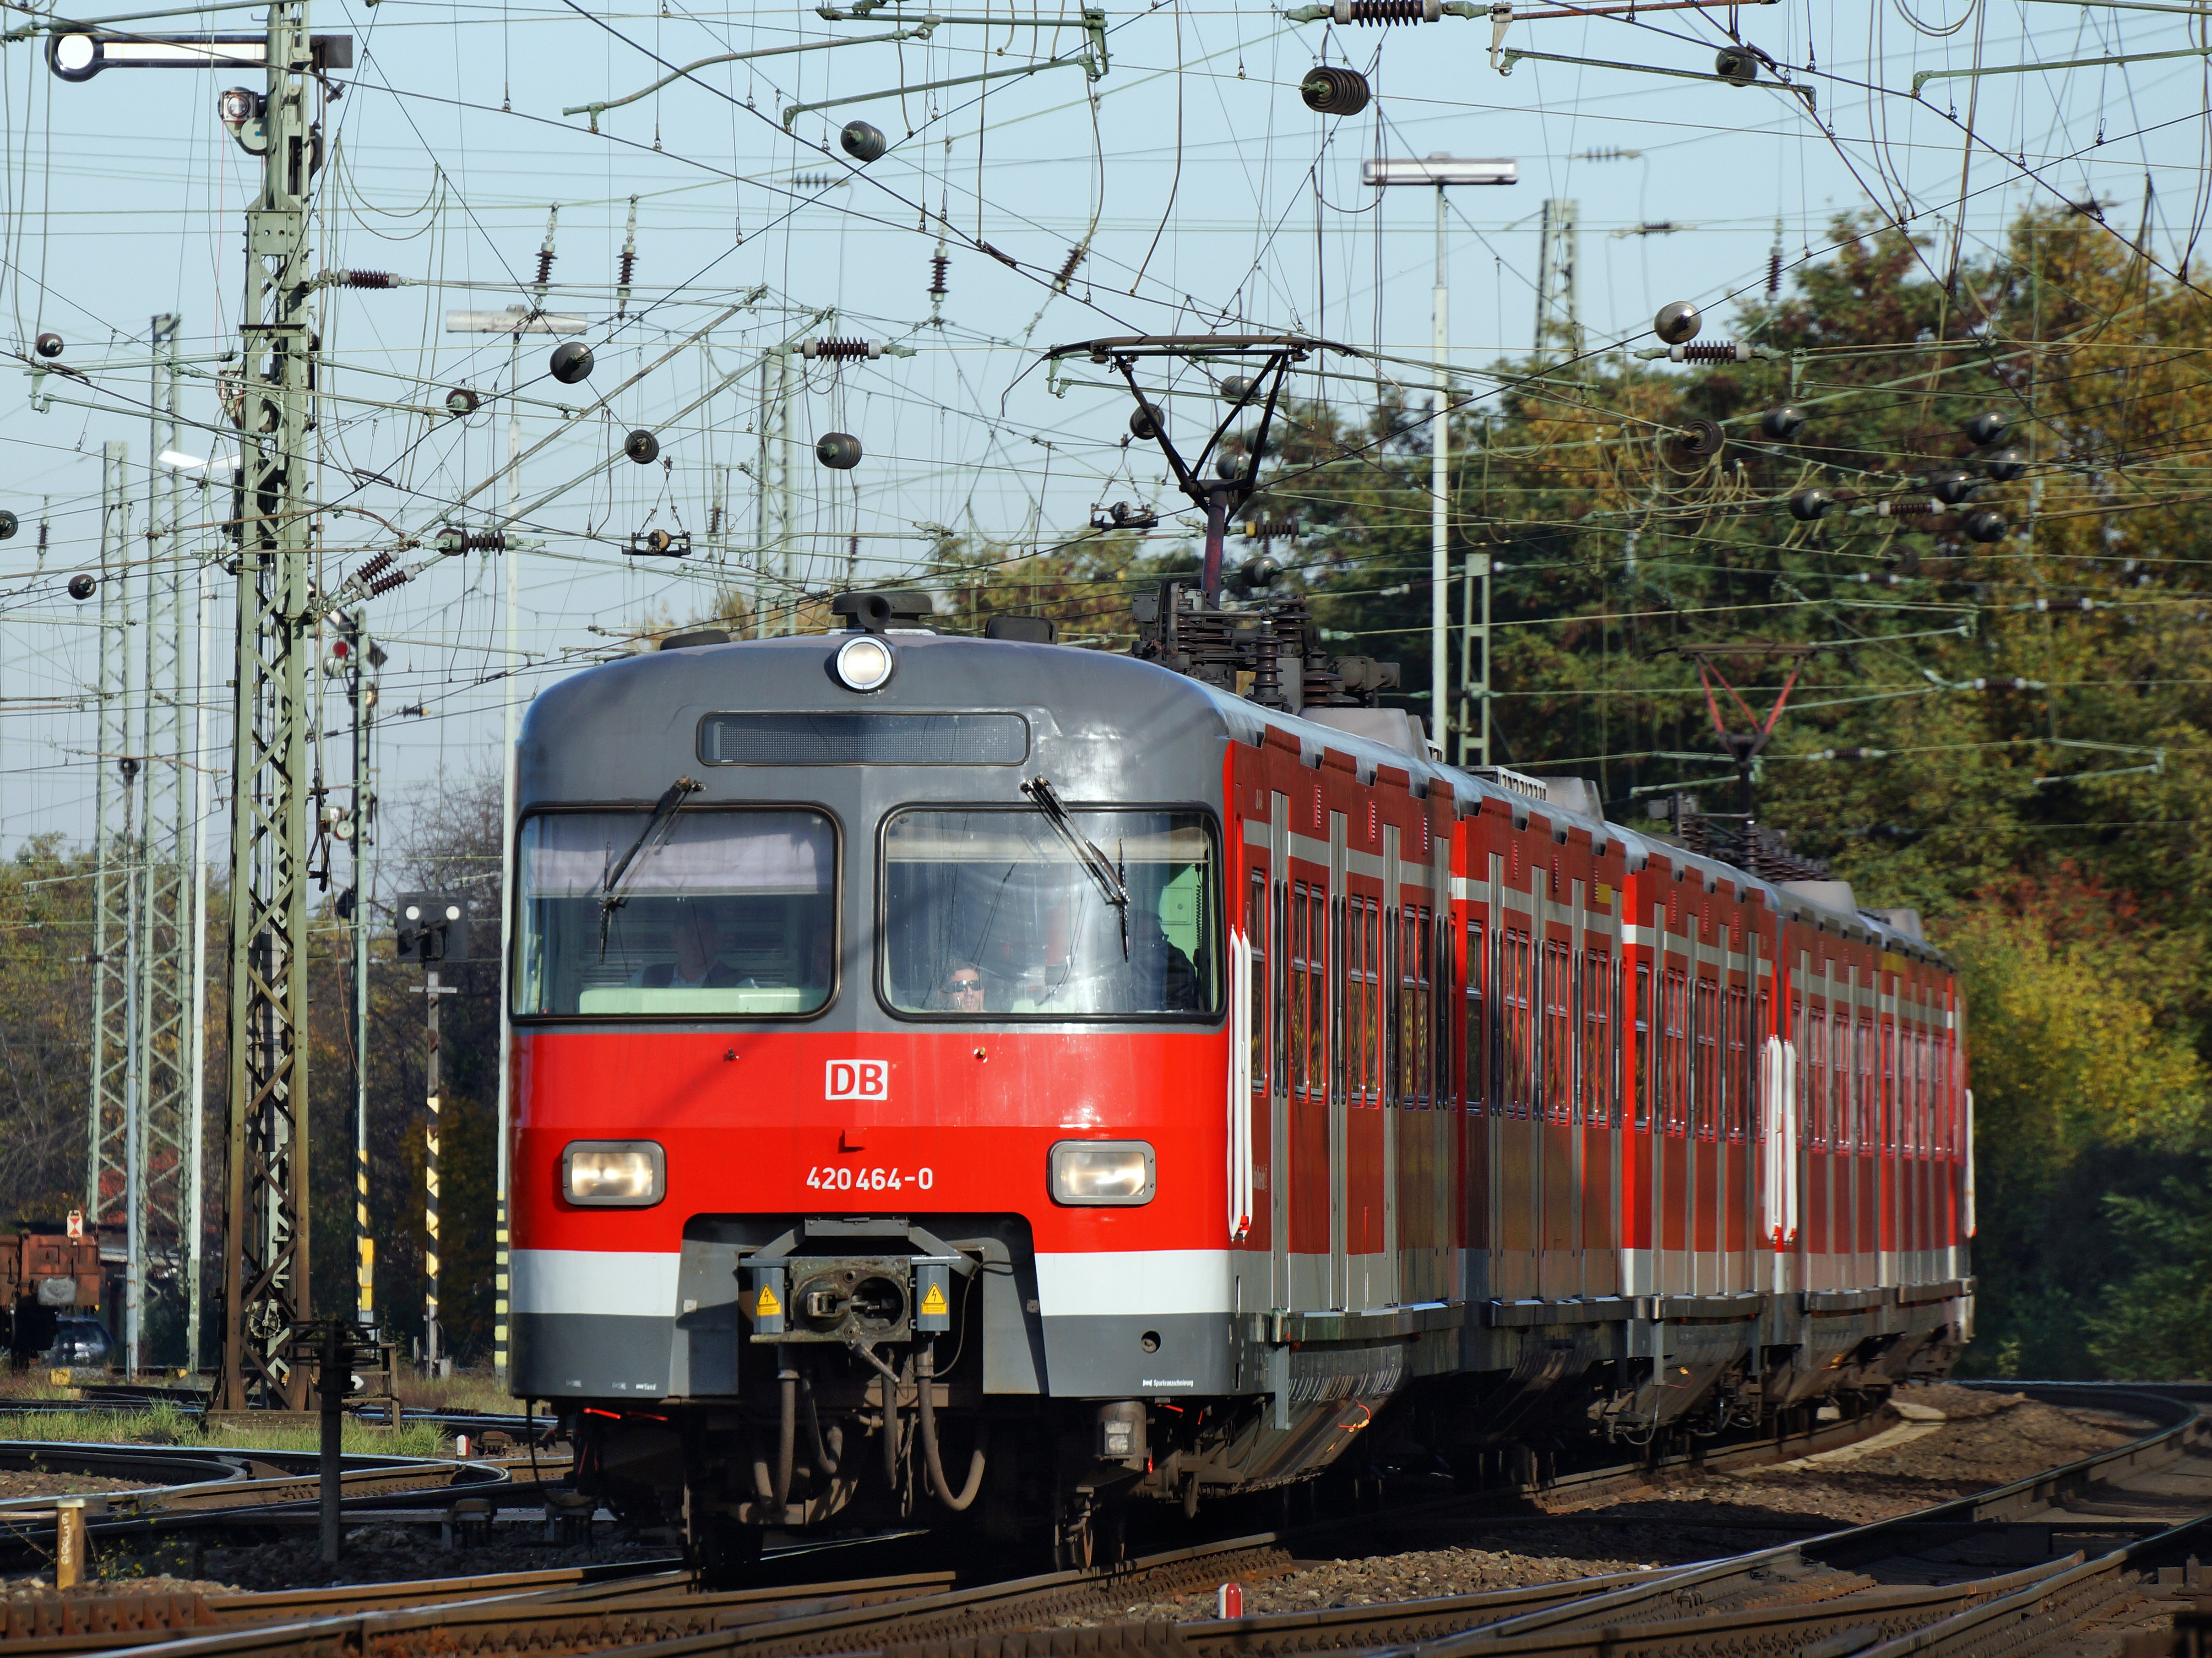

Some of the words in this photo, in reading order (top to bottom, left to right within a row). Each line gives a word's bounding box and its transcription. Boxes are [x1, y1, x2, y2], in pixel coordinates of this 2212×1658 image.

[830, 1064, 883, 1096] DB
[806, 1166, 851, 1190] 420
[855, 1168, 933, 1190] 464-0
